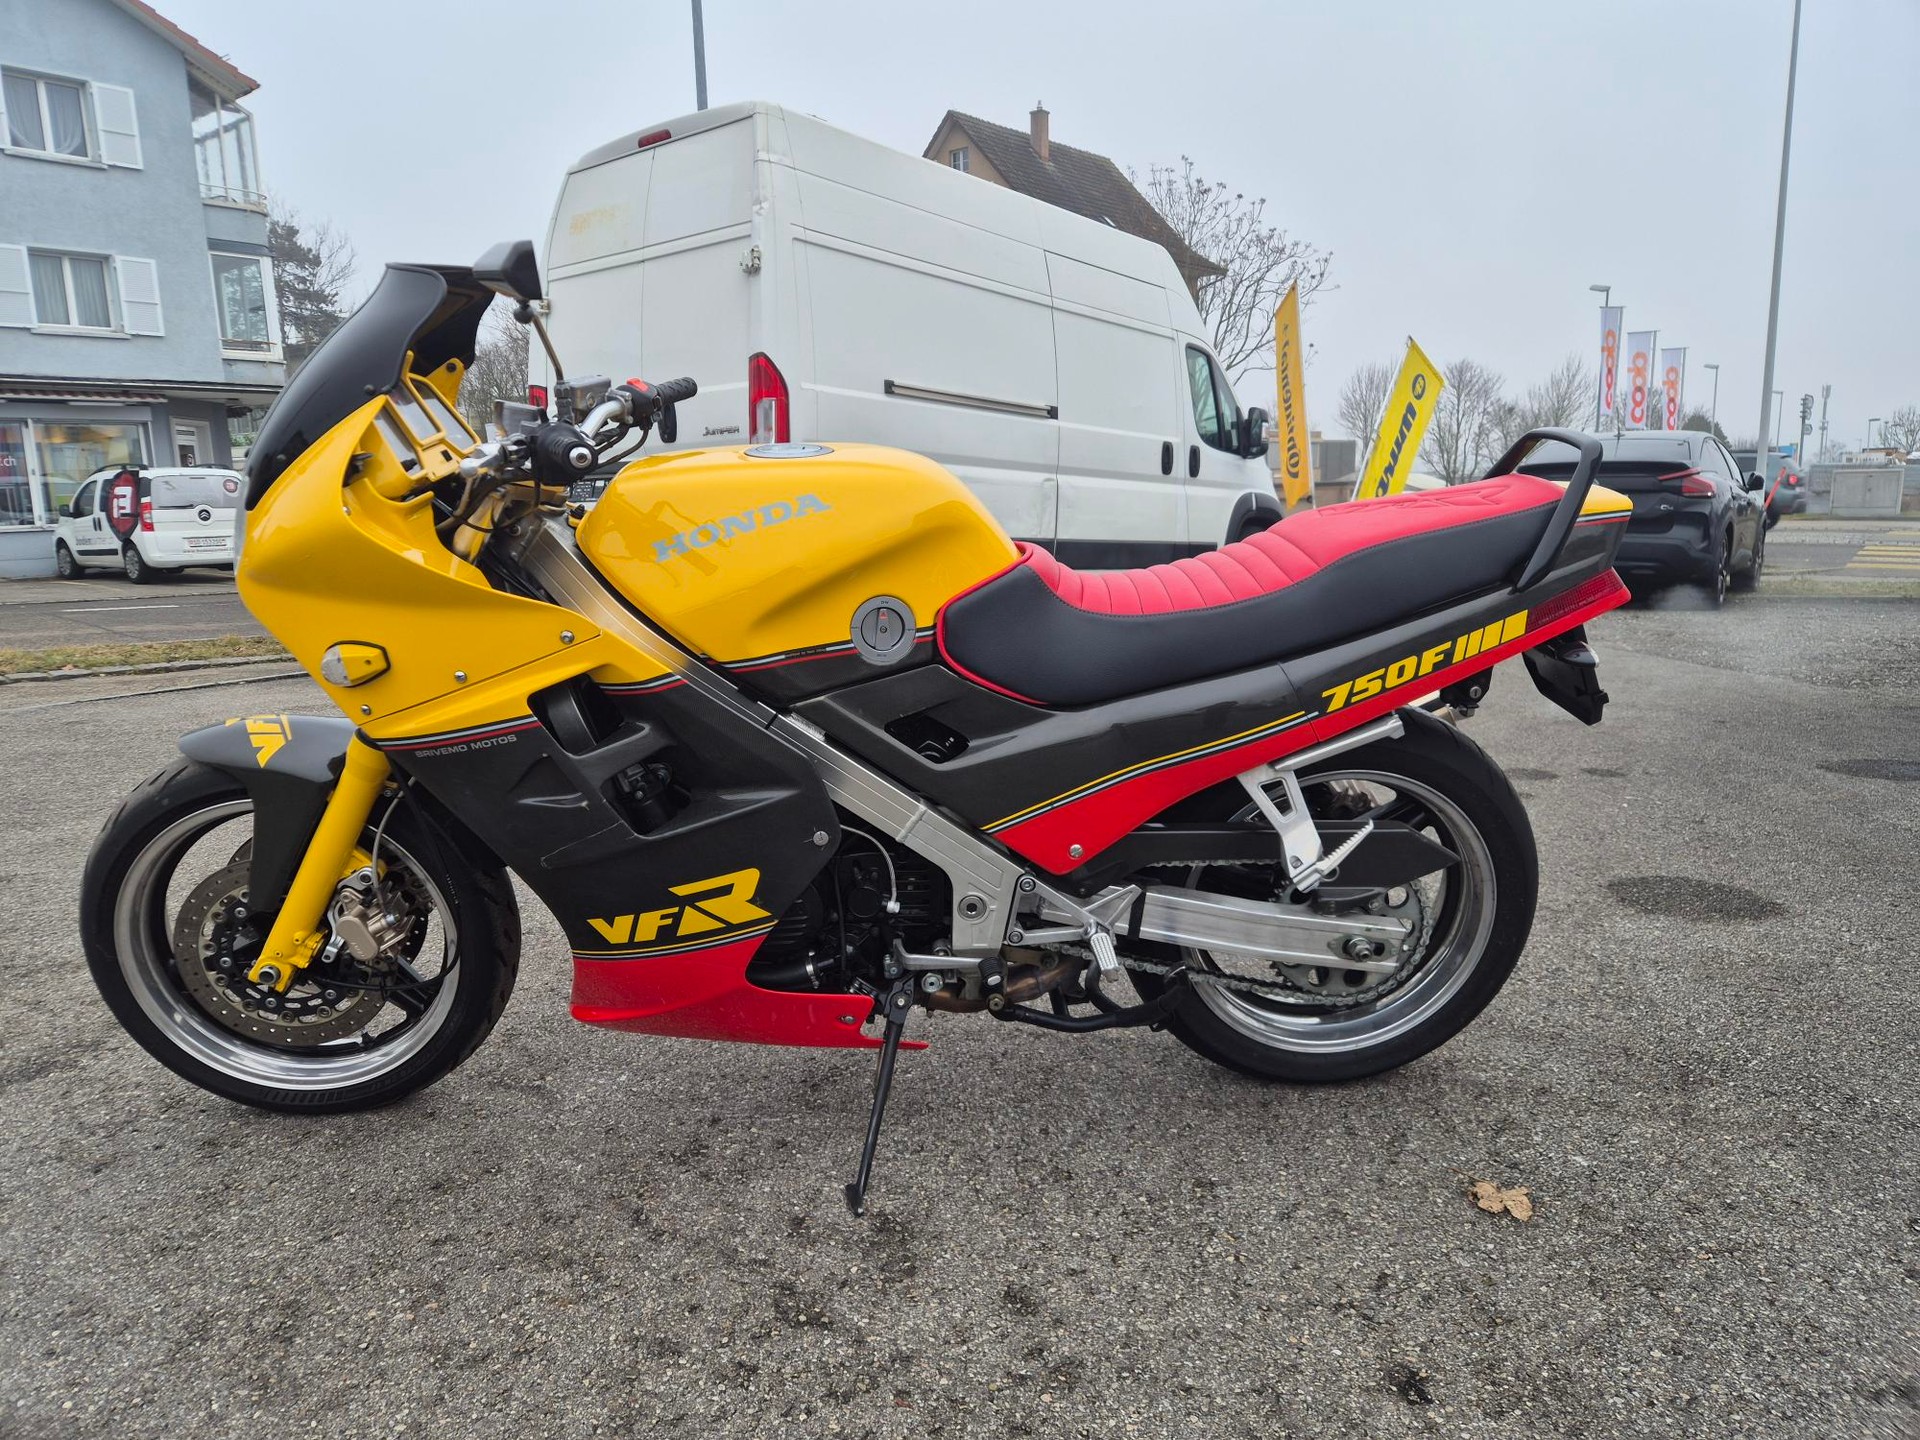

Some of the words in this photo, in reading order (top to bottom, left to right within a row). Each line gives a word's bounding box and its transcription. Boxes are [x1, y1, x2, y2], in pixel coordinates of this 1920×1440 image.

[652, 493, 832, 563] HONDA
[470, 734, 518, 750] MOTOS
[586, 867, 773, 944] VFR
